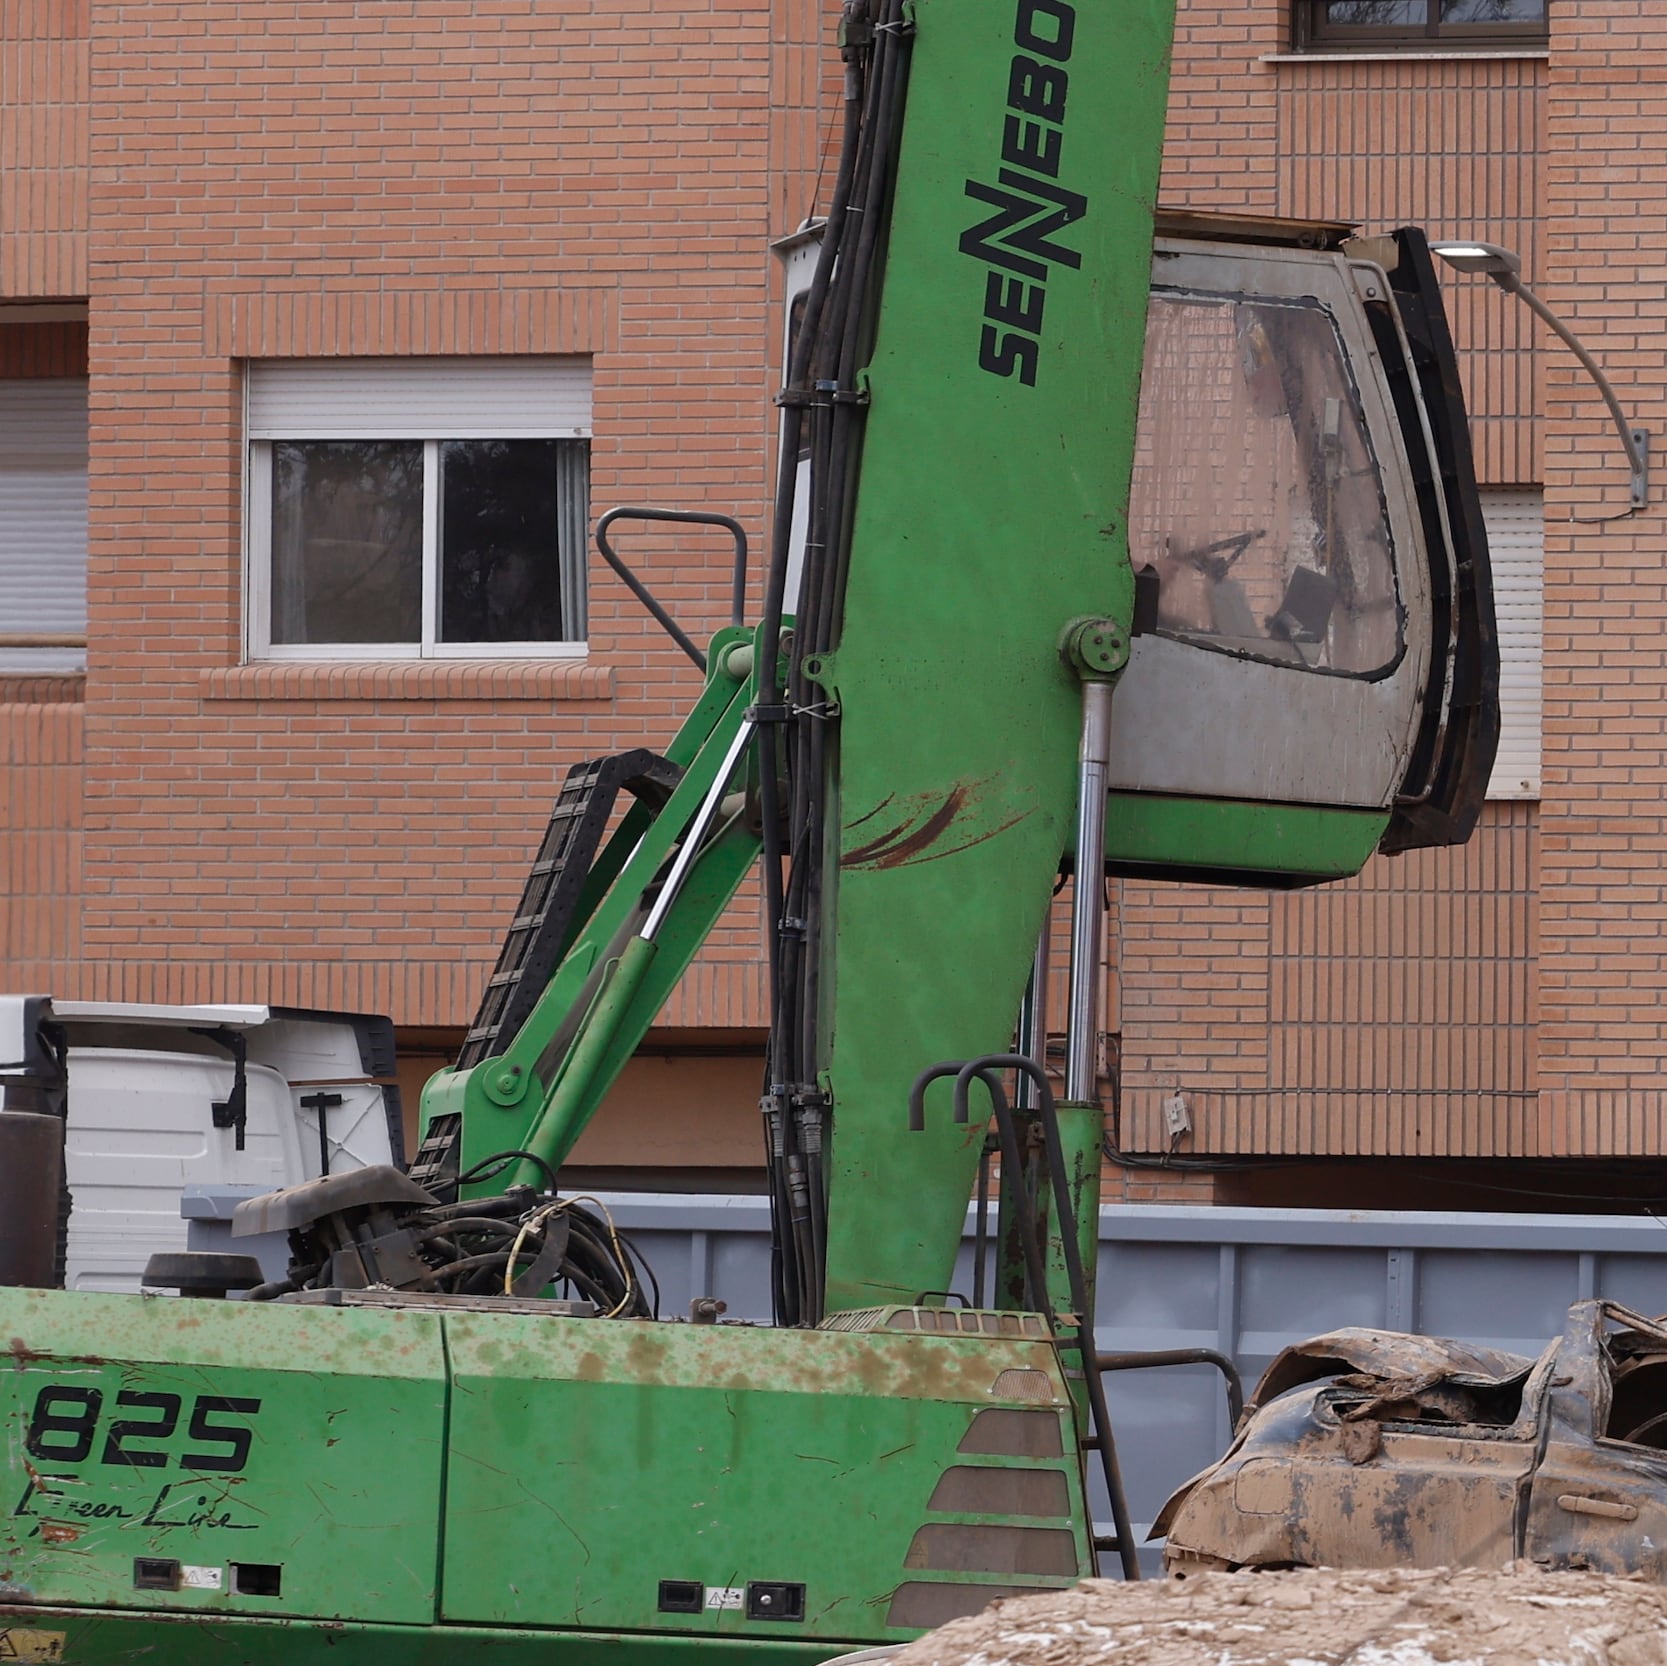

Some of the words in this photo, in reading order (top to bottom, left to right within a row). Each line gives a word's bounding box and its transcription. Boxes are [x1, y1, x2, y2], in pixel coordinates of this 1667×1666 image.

[958, 0, 1088, 388] SENNEBO
[27, 1385, 262, 1473] 825
[142, 1484, 260, 1529] Line
